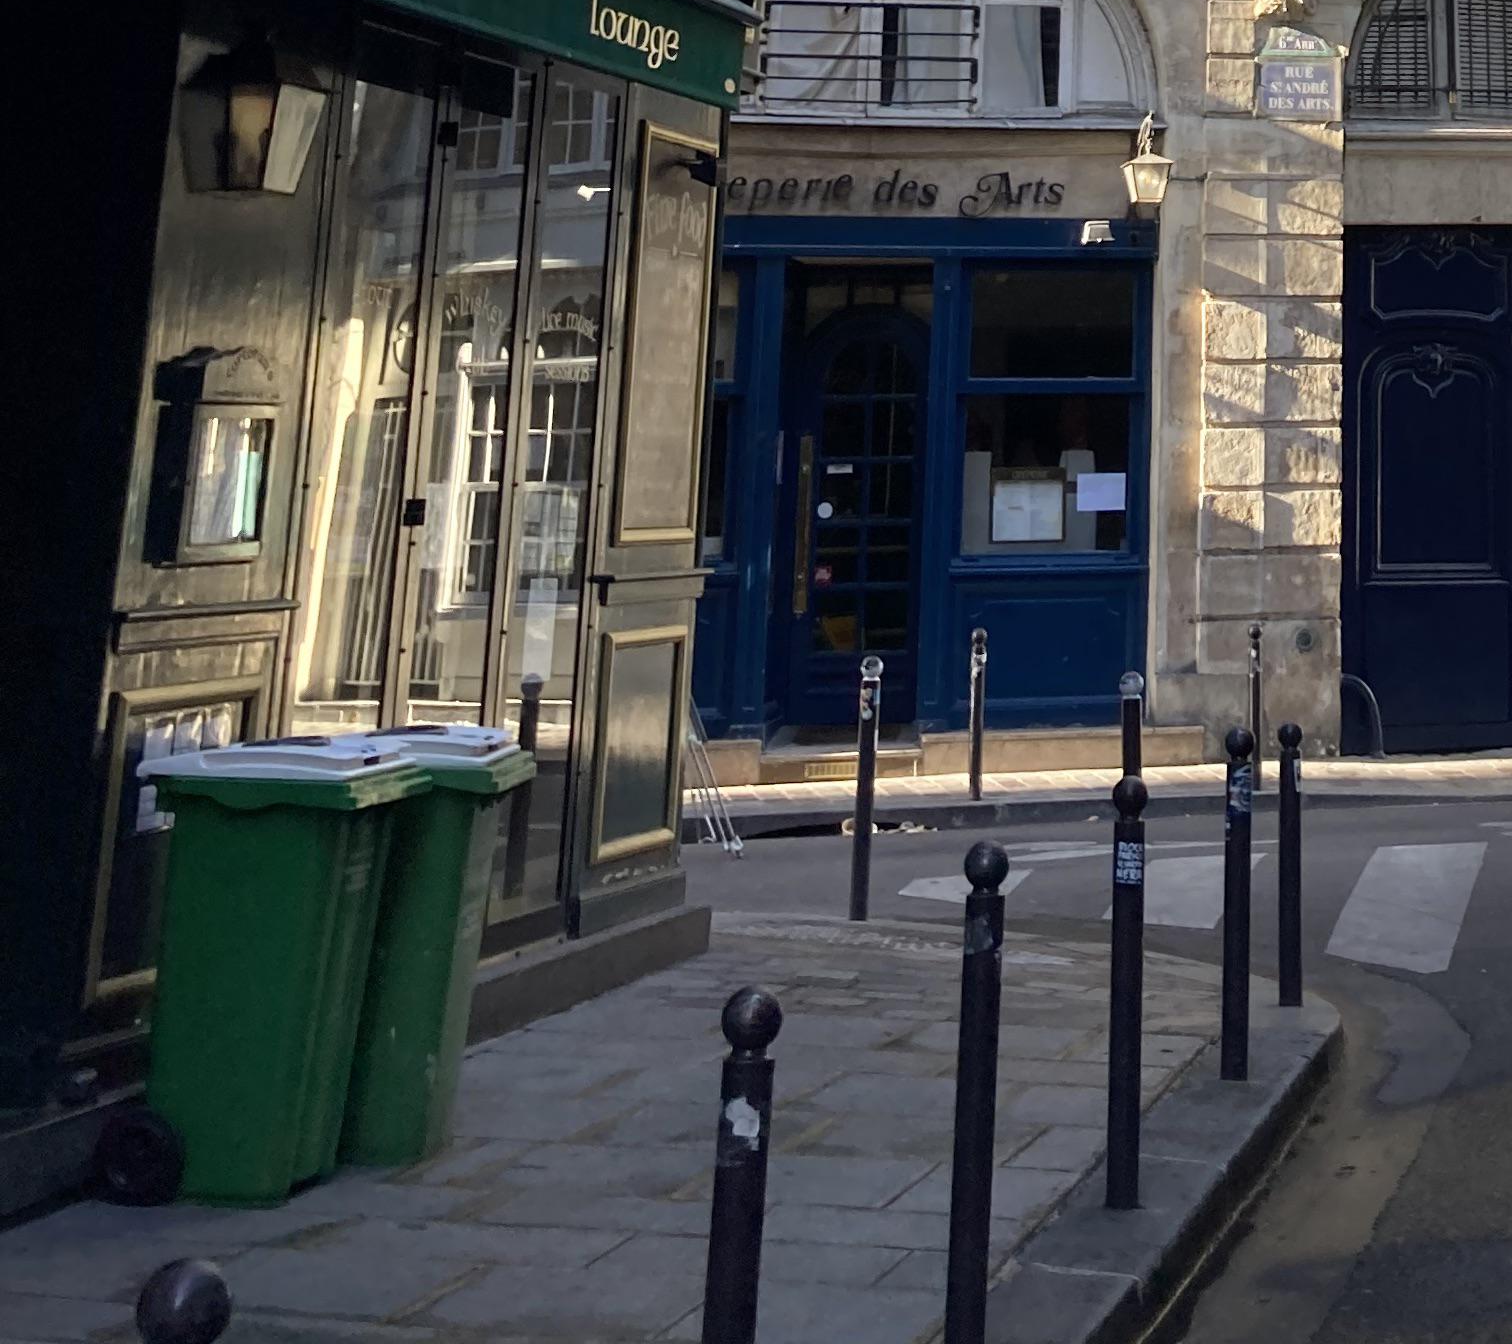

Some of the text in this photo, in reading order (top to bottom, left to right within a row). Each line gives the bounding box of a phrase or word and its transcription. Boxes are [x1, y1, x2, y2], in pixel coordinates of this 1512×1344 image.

[1284, 66, 1314, 79] RUE
[1287, 80, 1329, 95] ANDRÉ
[1268, 97, 1295, 109] DES
[873, 169, 939, 208] des
[958, 170, 1067, 217] Arts
